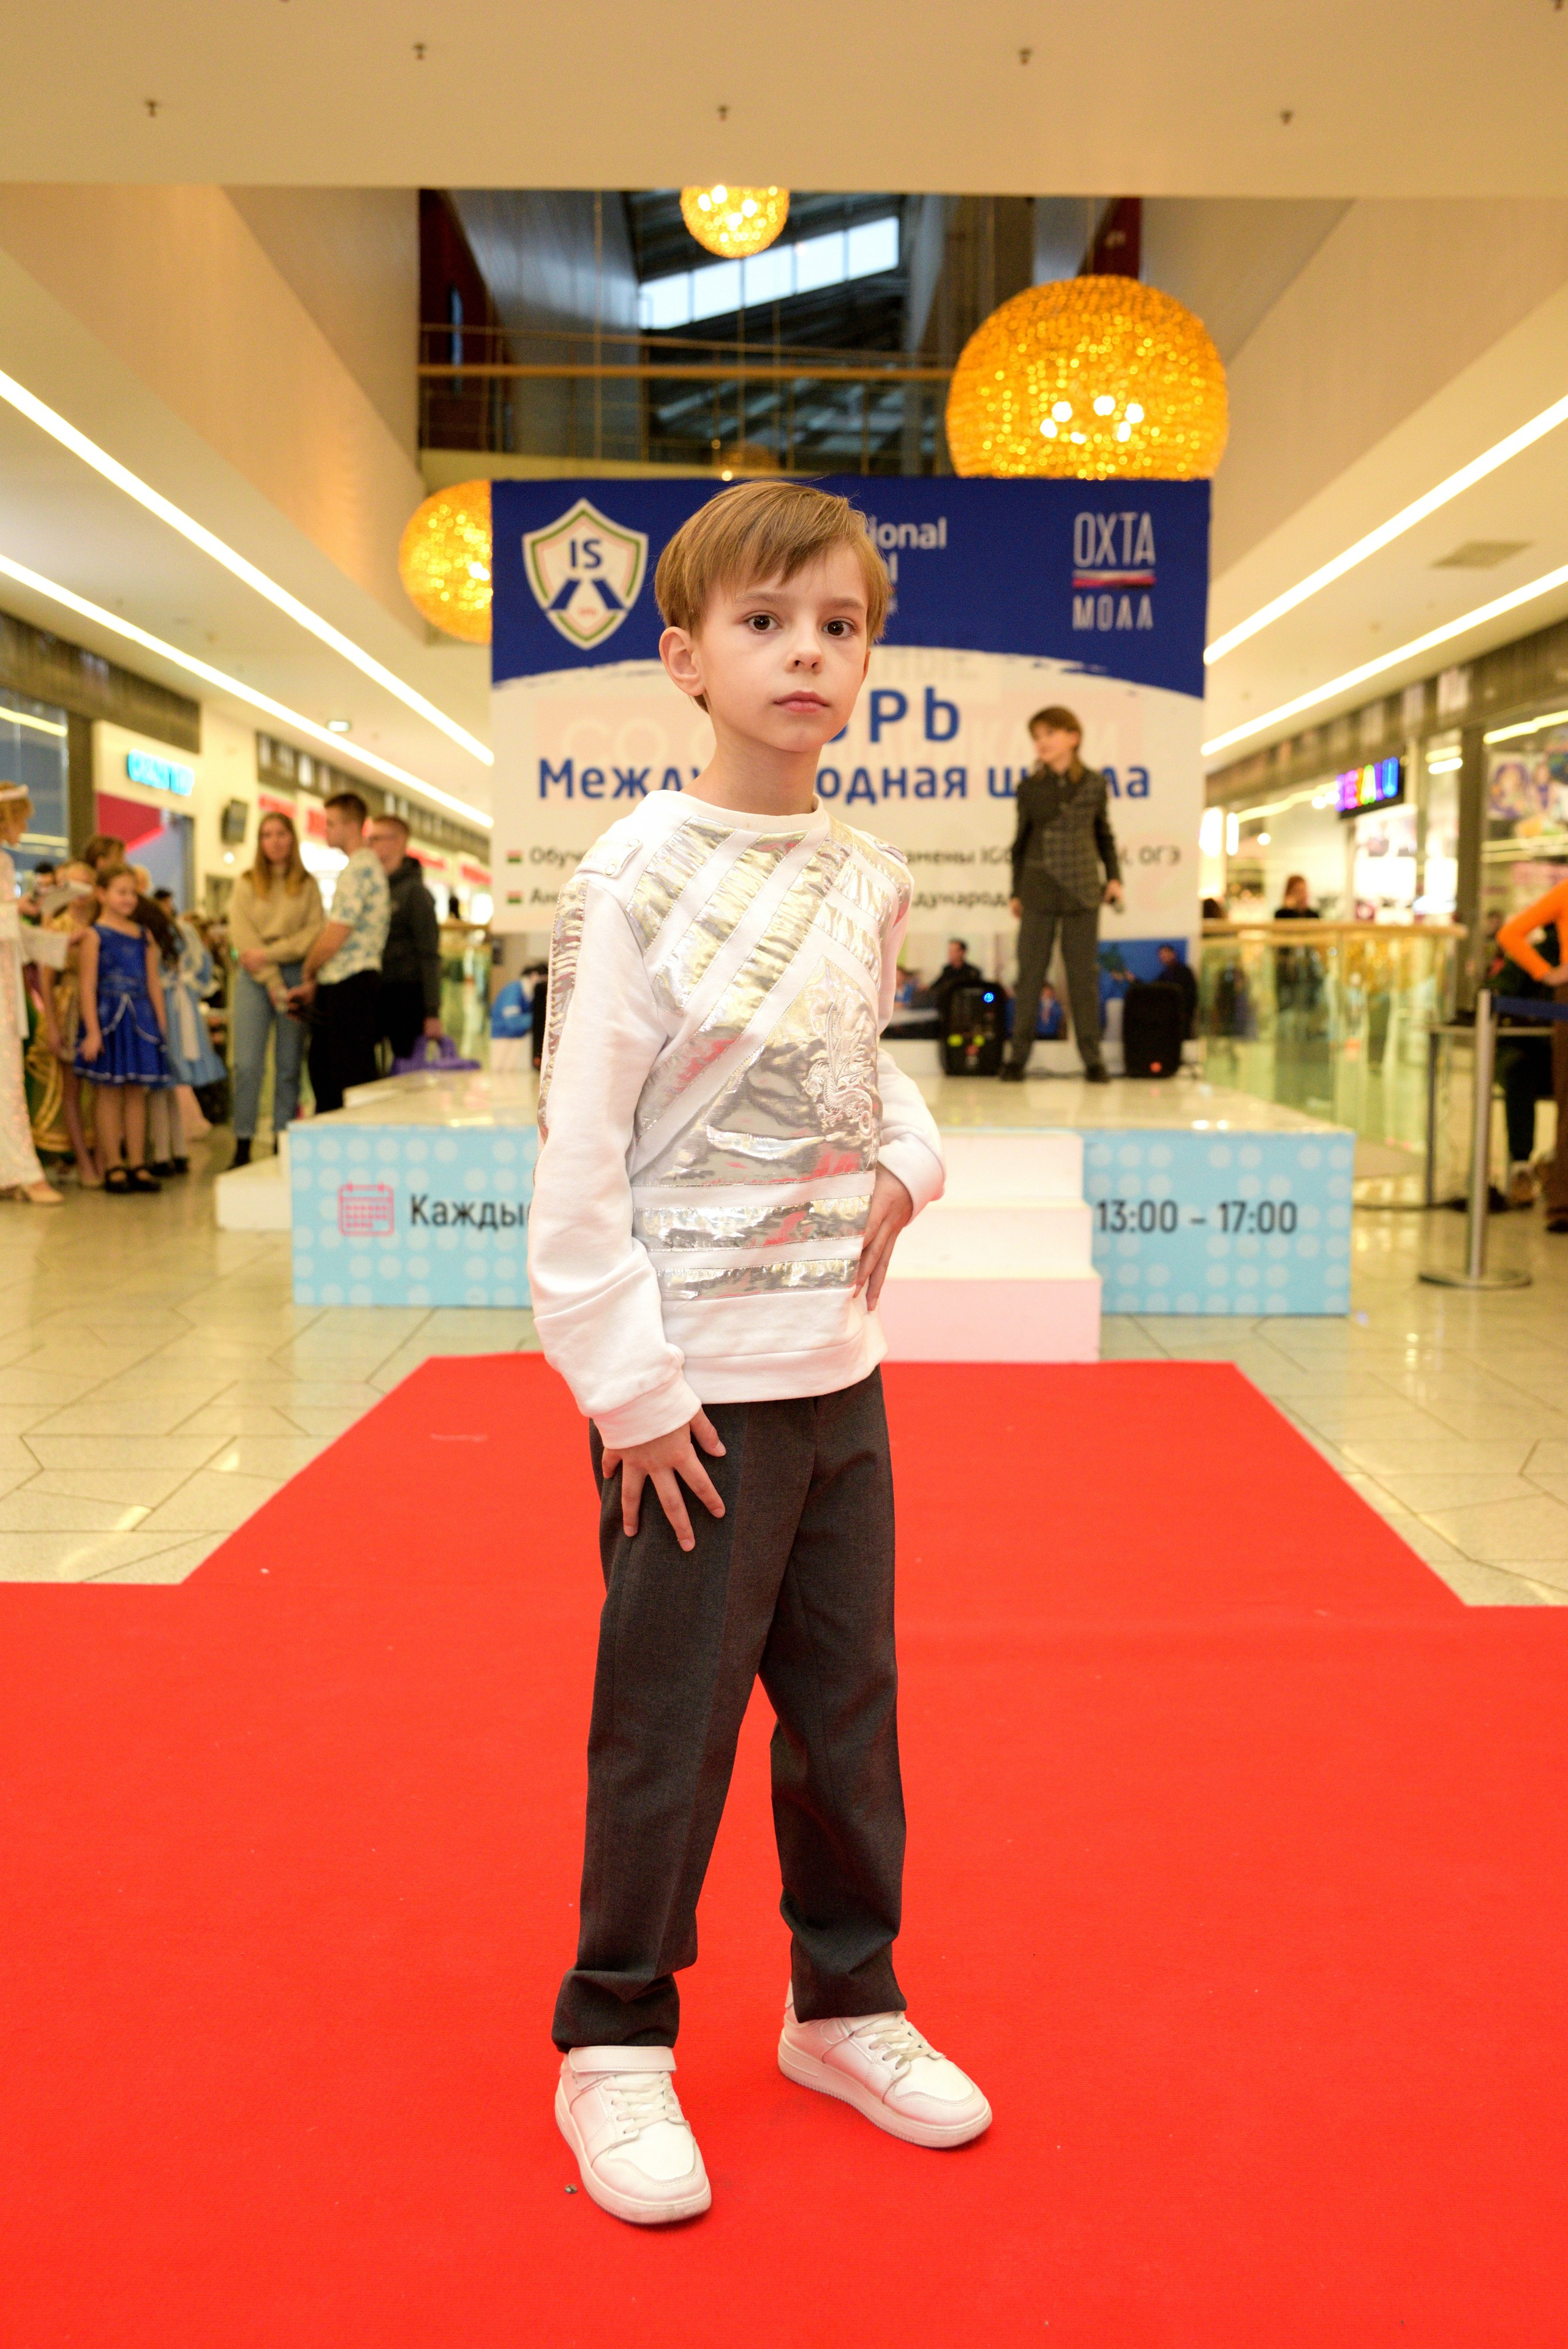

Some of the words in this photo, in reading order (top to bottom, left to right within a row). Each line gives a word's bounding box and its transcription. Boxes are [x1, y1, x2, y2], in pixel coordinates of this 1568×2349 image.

[570, 540, 603, 569] IS
[1074, 512, 1156, 566] ОХТА
[410, 1194, 530, 1231] Кажды
[1098, 1199, 1179, 1234] 13:00
[1219, 1200, 1298, 1234] 17:00
